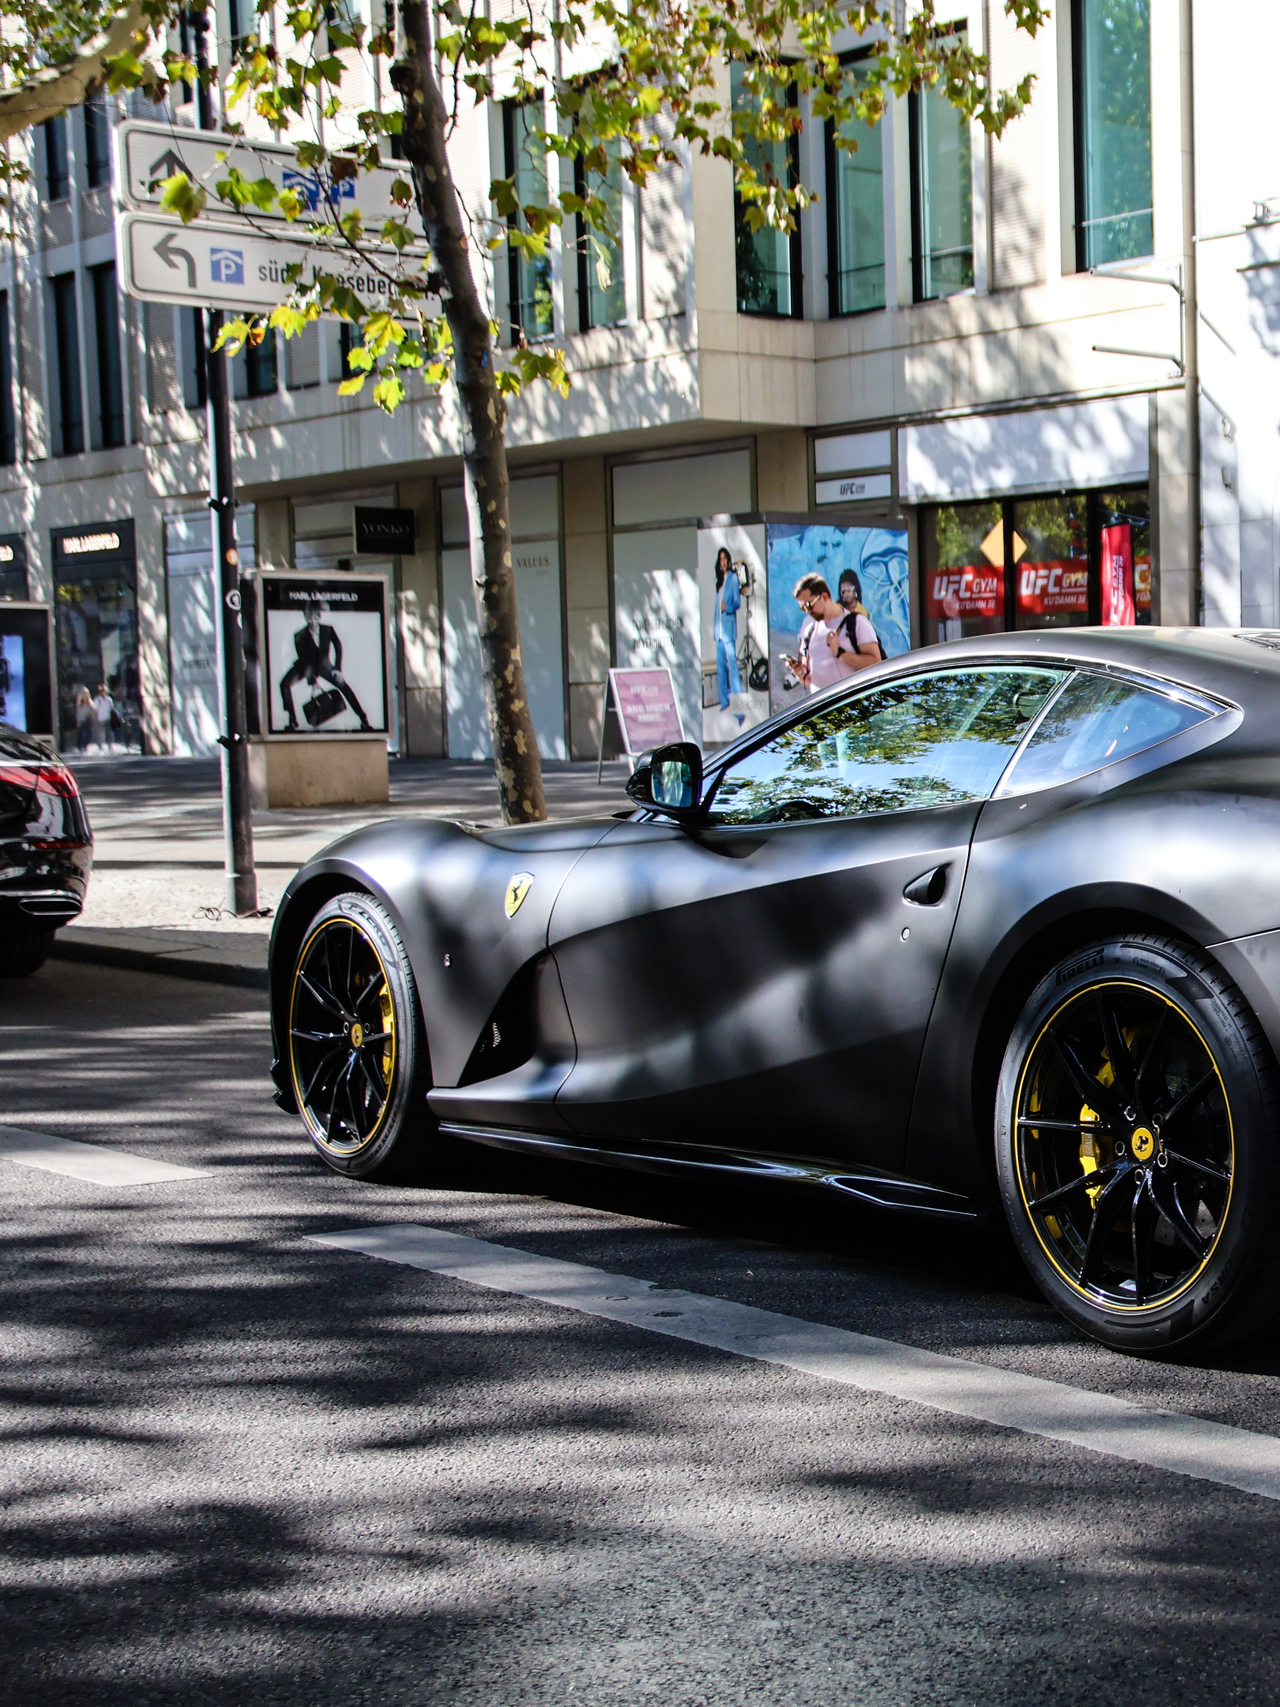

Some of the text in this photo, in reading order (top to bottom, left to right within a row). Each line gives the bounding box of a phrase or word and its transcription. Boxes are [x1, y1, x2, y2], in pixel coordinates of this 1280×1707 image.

[933, 573, 998, 600] UFC GYM
[1020, 568, 1088, 596] UFC GYM
[1055, 947, 1106, 987] PIRELLI
